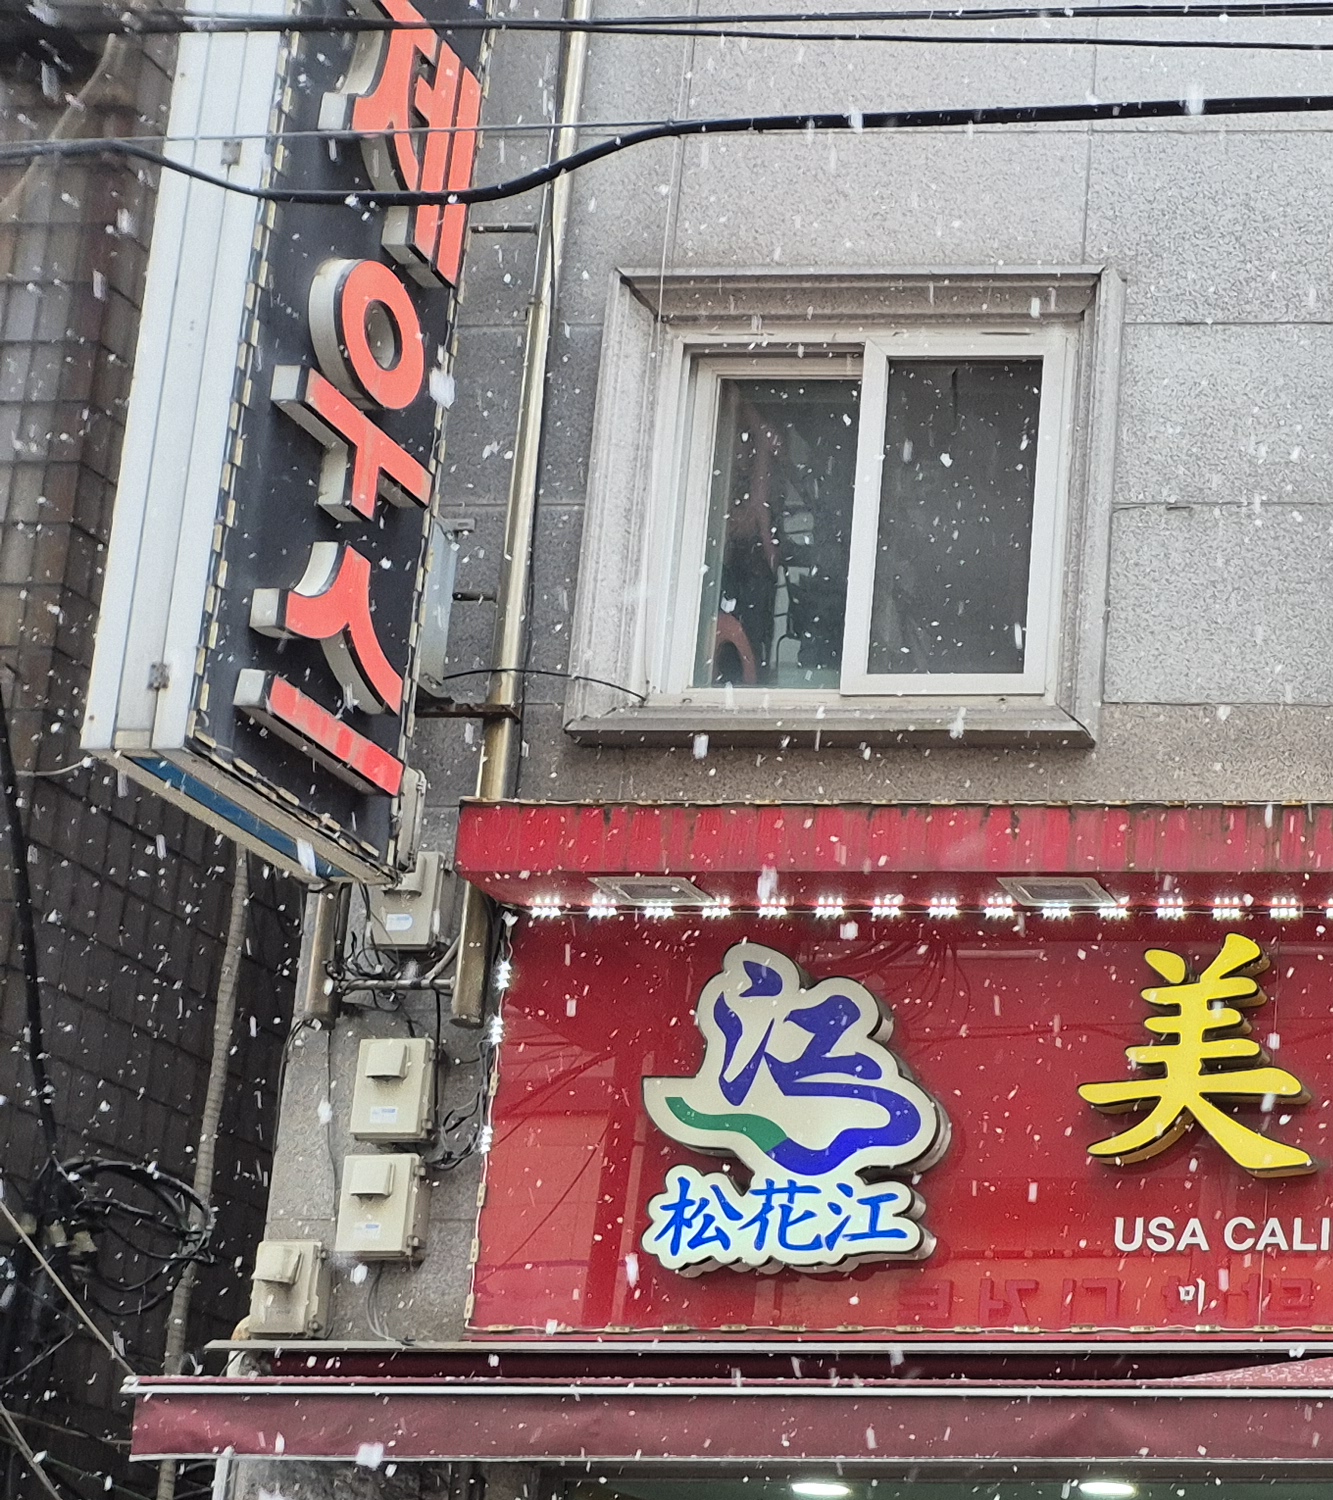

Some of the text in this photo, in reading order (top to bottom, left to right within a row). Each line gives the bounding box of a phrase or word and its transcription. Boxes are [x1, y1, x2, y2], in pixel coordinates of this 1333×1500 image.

[658, 1175, 909, 1256] 松花江
[1114, 1216, 1210, 1253] USA
